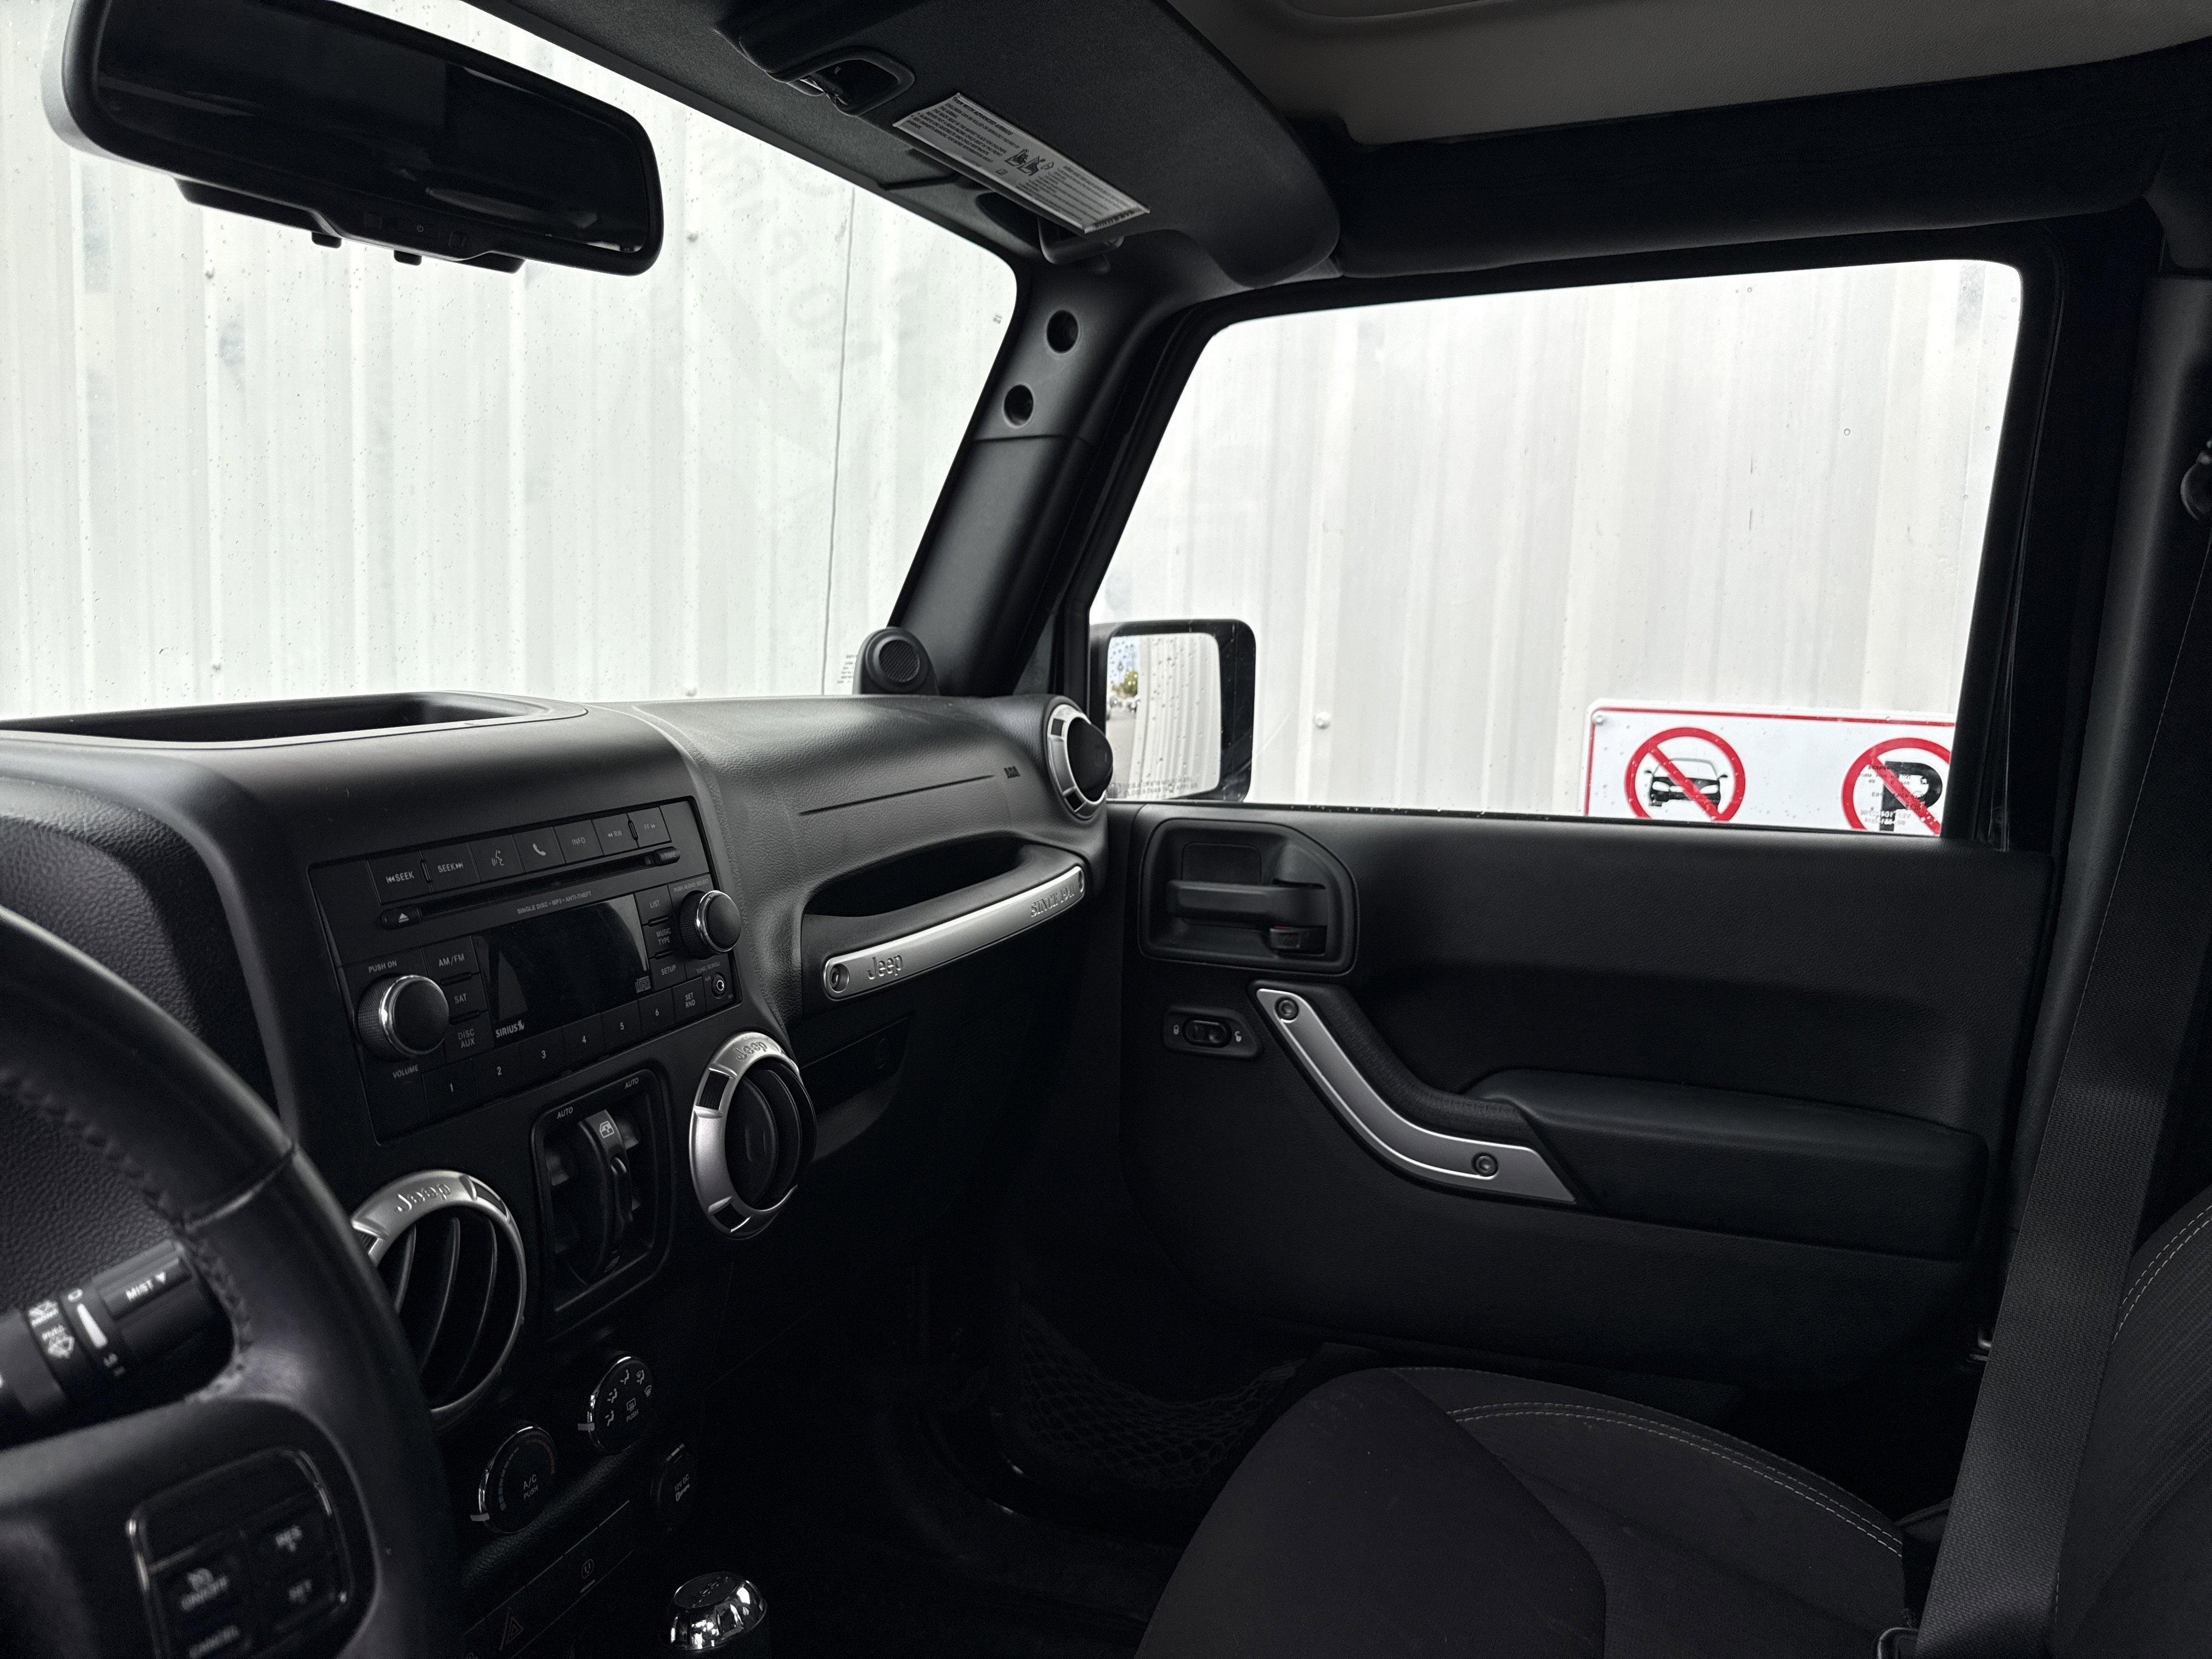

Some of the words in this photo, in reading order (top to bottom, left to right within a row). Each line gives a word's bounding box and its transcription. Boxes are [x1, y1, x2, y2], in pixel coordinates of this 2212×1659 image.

[613, 829, 623, 838] RW
[571, 836, 586, 846] INFO
[664, 850, 676, 859] TIME
[438, 861, 456, 873] SEEK
[395, 871, 415, 883] SEEK
[517, 905, 536, 915] SINGLE
[536, 902, 549, 910] DISC
[565, 890, 592, 902] ANTI-THEFT
[649, 899, 661, 909] LIST
[1030, 894, 1059, 918] SINCE
[656, 927, 672, 938] MUSIC
[658, 936, 671, 946] TYPE
[438, 953, 465, 968] AM/FM
[368, 963, 386, 974] PUSH
[386, 960, 397, 969] ON
[661, 964, 677, 976] SETUP
[867, 954, 903, 980] Jeep
[454, 993, 467, 1005] SAT
[684, 991, 695, 1001] SET
[685, 998, 696, 1008] RND
[654, 1007, 659, 1017] 6
[495, 1023, 518, 1039] SIRIUS
[619, 1021, 624, 1031] 5
[458, 1029, 476, 1041] DISC
[581, 1035, 587, 1045] 4
[460, 1037, 476, 1049] AUX
[540, 1049, 547, 1059] 3
[734, 1040, 768, 1062] Jeep
[392, 1064, 419, 1080] VOLUME
[496, 1066, 503, 1076] 2
[449, 1082, 454, 1093] 1
[624, 1076, 640, 1090] AUTO
[556, 1105, 573, 1120] AUTO
[395, 1183, 452, 1214] Jeep
[125, 1279, 154, 1302] MIST
[626, 1408, 639, 1423] PUSH
[523, 1474, 537, 1491] A/C
[682, 1474, 690, 1485] DC
[523, 1484, 538, 1500] PUSH
